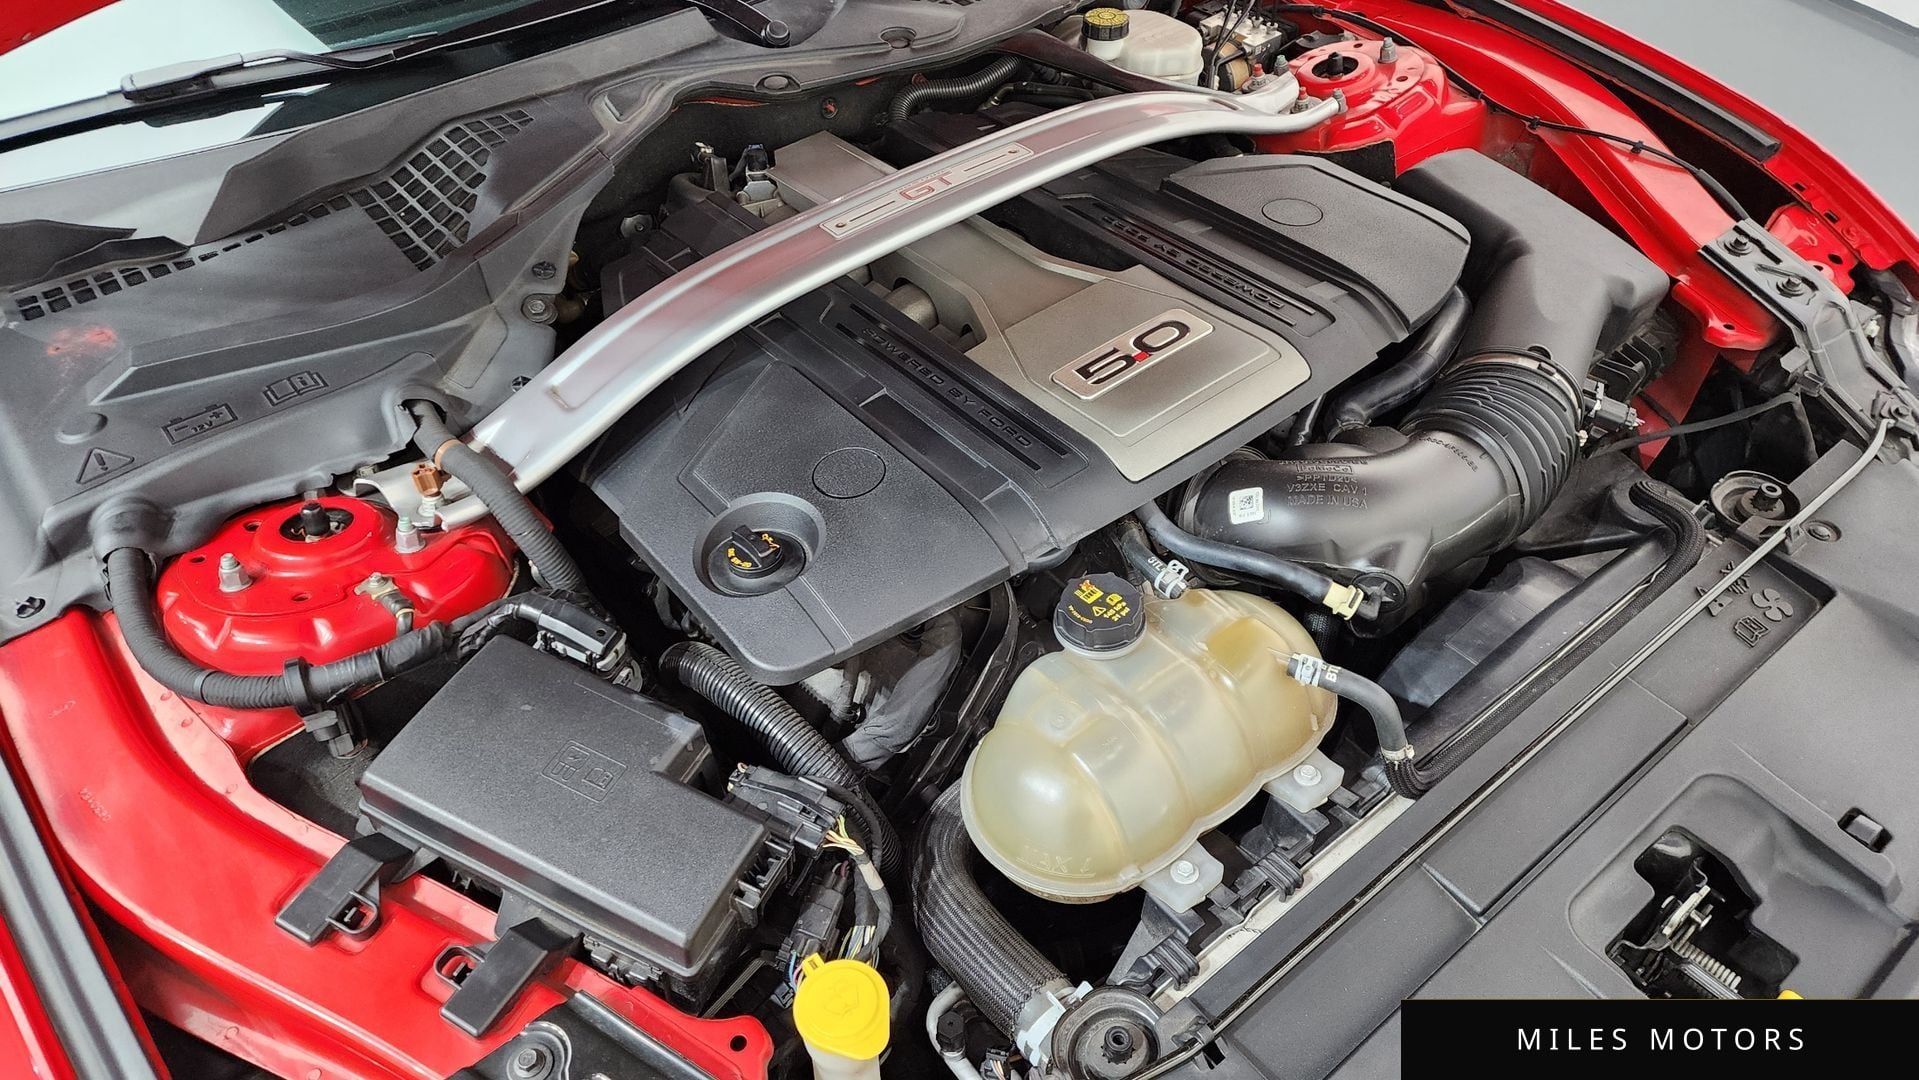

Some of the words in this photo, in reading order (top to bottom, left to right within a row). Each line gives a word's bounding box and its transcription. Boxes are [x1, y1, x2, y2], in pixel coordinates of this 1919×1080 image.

[899, 170, 953, 201] GT
[1186, 258, 1285, 310] POWERED
[1073, 320, 1191, 385] 5.0
[862, 328, 945, 386] POWERED
[949, 387, 978, 406] BY
[978, 408, 1033, 448] FORD
[1287, 494, 1324, 507] MADE
[1327, 495, 1340, 505] IN
[1343, 495, 1368, 510] USA
